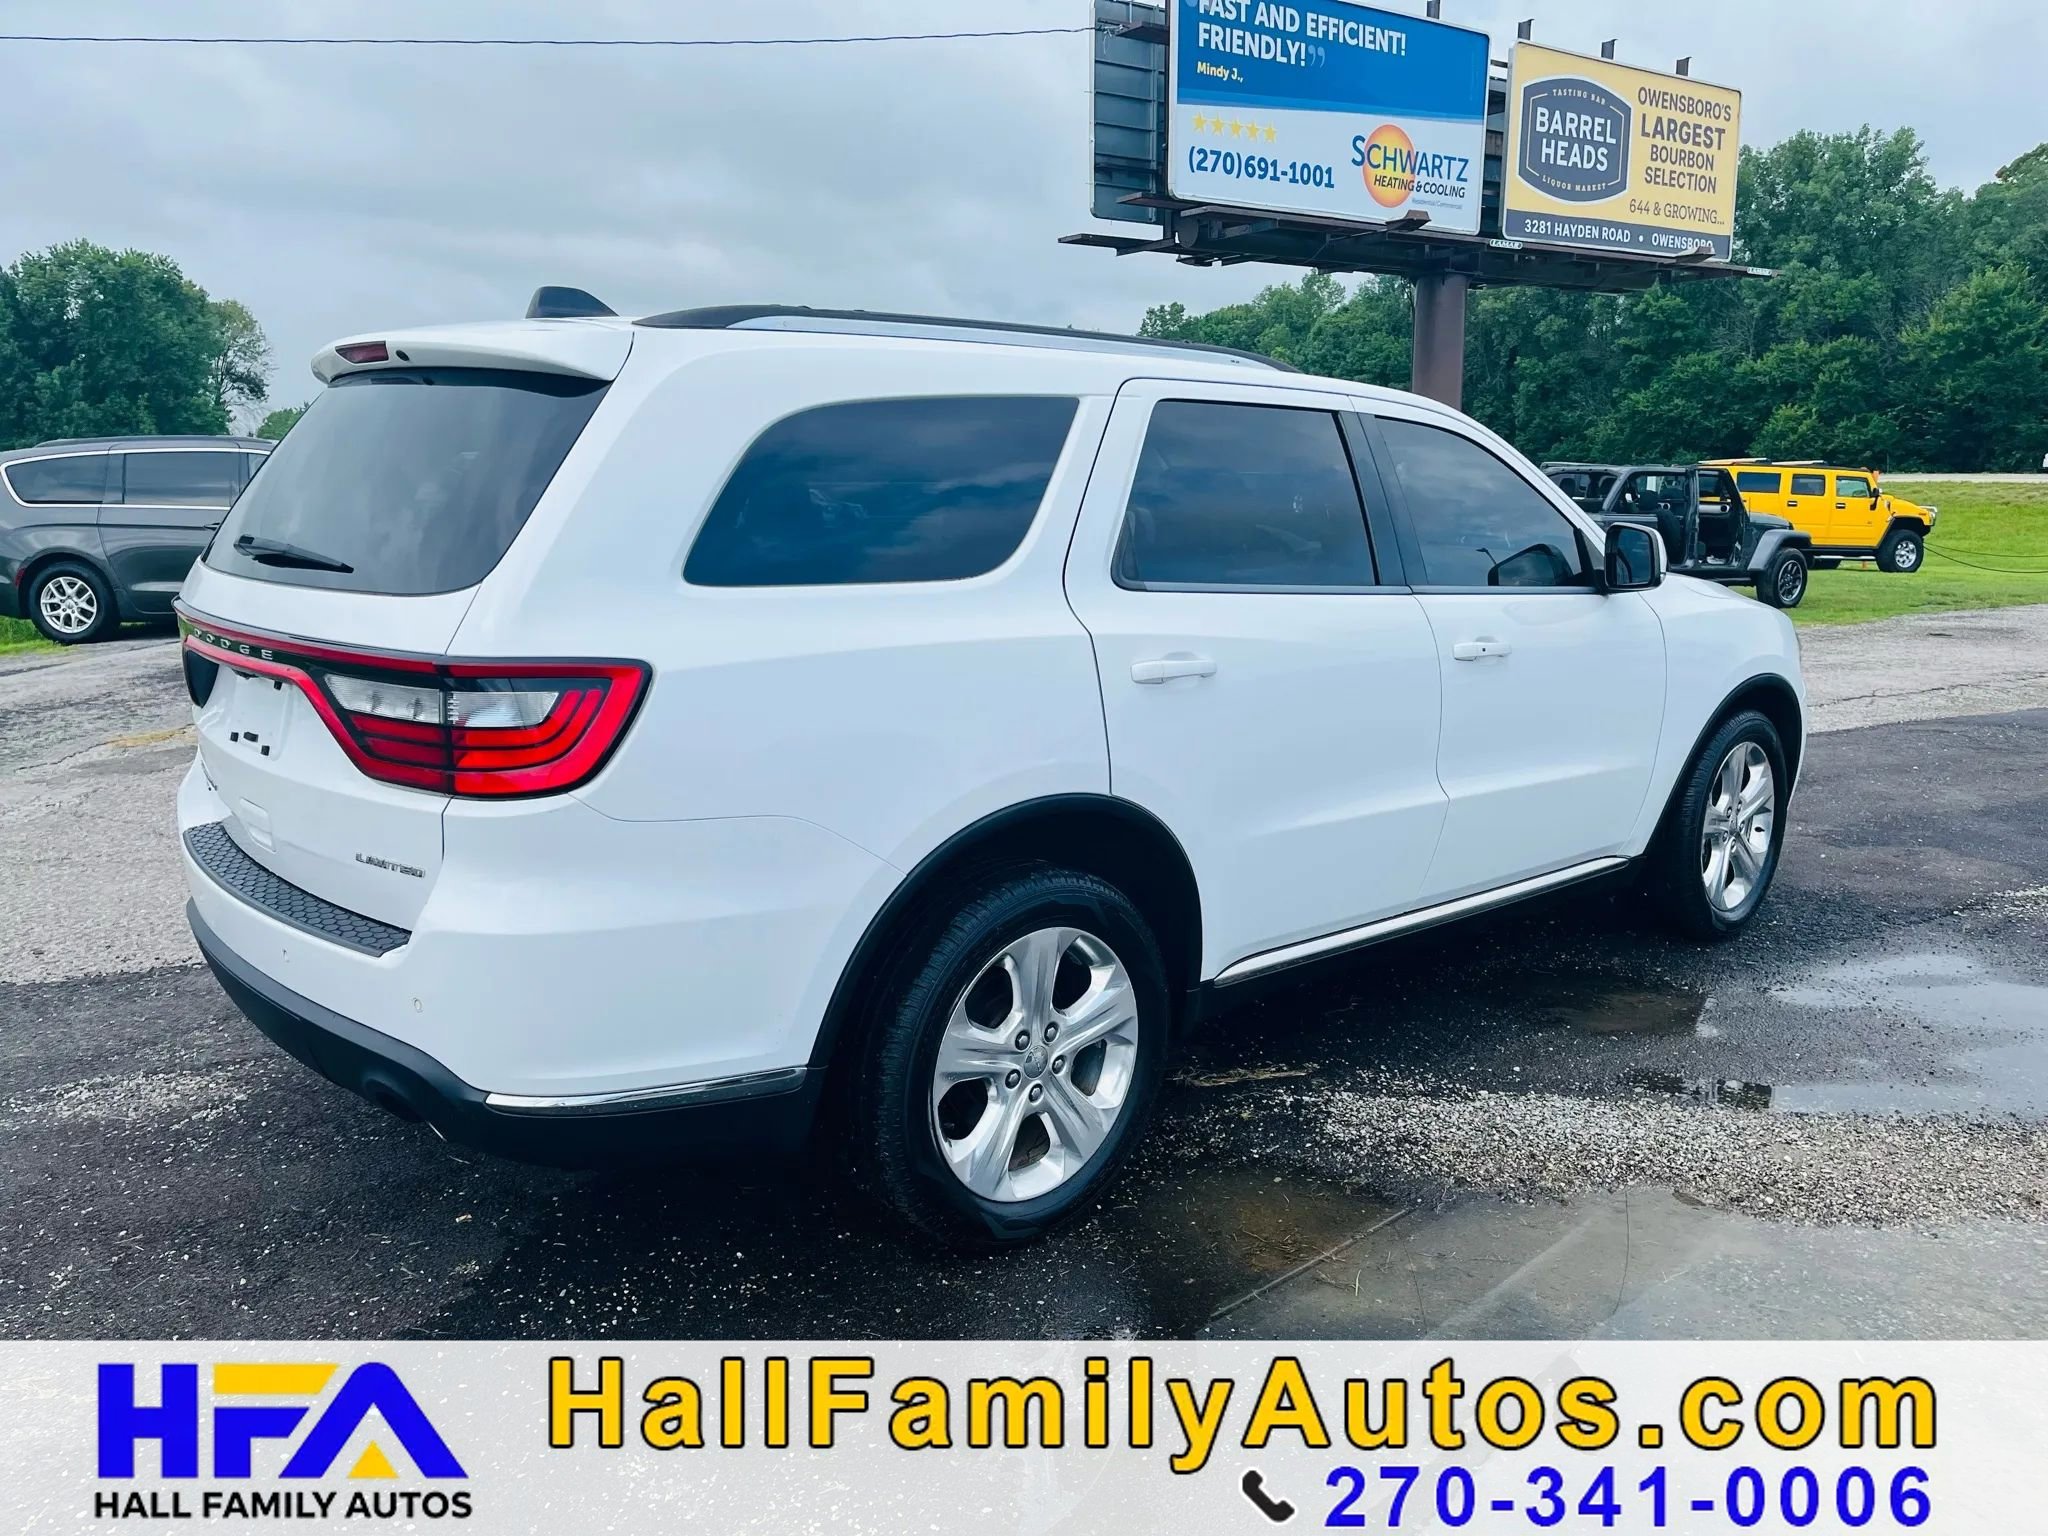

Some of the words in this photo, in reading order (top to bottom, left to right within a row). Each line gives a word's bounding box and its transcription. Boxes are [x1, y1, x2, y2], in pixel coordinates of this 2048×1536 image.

[1254, 2, 1300, 33] AND
[1306, 13, 1407, 56] EFFICIENT!
[1197, 61, 1230, 81] Mindy
[1553, 88, 1588, 99] TASTING
[1591, 94, 1606, 105] BAR
[1638, 86, 1732, 122] OWENSBORO'S
[1535, 106, 1617, 145] BARREL
[1640, 113, 1726, 151] LARGEST
[1188, 146, 1335, 189] (270)691-1001
[1351, 135, 1469, 182] SCHWARTZ
[1541, 138, 1608, 172] HEADS
[1650, 144, 1714, 171] BOURBON
[1373, 174, 1415, 192] HEATING
[1423, 181, 1466, 199] COOLING
[1542, 174, 1572, 191] LIQUOR
[1575, 182, 1606, 192] MARKET
[1644, 166, 1717, 194] SELECTION
[1629, 199, 1651, 216] 644
[1653, 202, 1662, 217] &
[1663, 204, 1725, 226] GROWING...
[1524, 219, 1552, 234] 3281
[1554, 222, 1600, 239] HAYDEN
[1602, 227, 1631, 243] ROAD
[194, 628, 273, 660] DODGE
